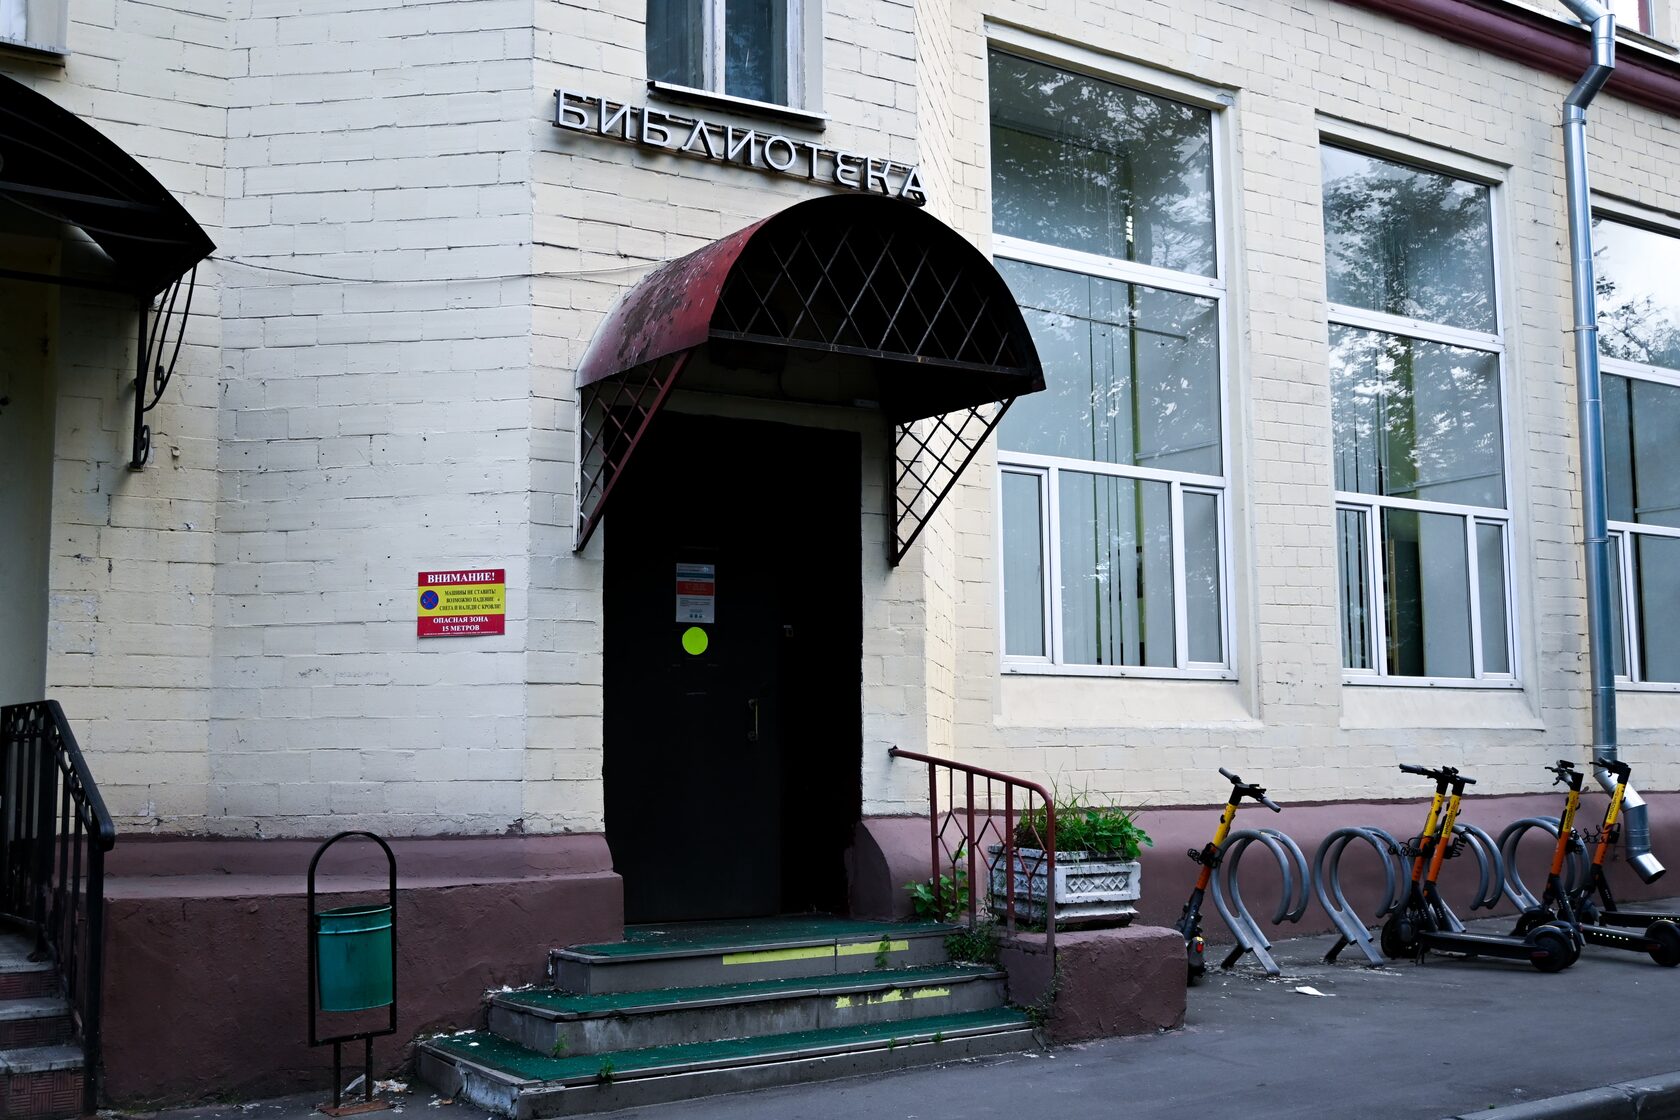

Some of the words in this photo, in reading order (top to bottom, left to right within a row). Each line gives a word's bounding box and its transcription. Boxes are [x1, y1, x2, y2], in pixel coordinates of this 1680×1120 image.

[554, 88, 928, 203] БИБЛИОТЕКА
[427, 572, 495, 584] ВНИМАНИЕ!
[433, 616, 468, 624] ОПАСНАЯ
[469, 615, 489, 623] ЗОНА
